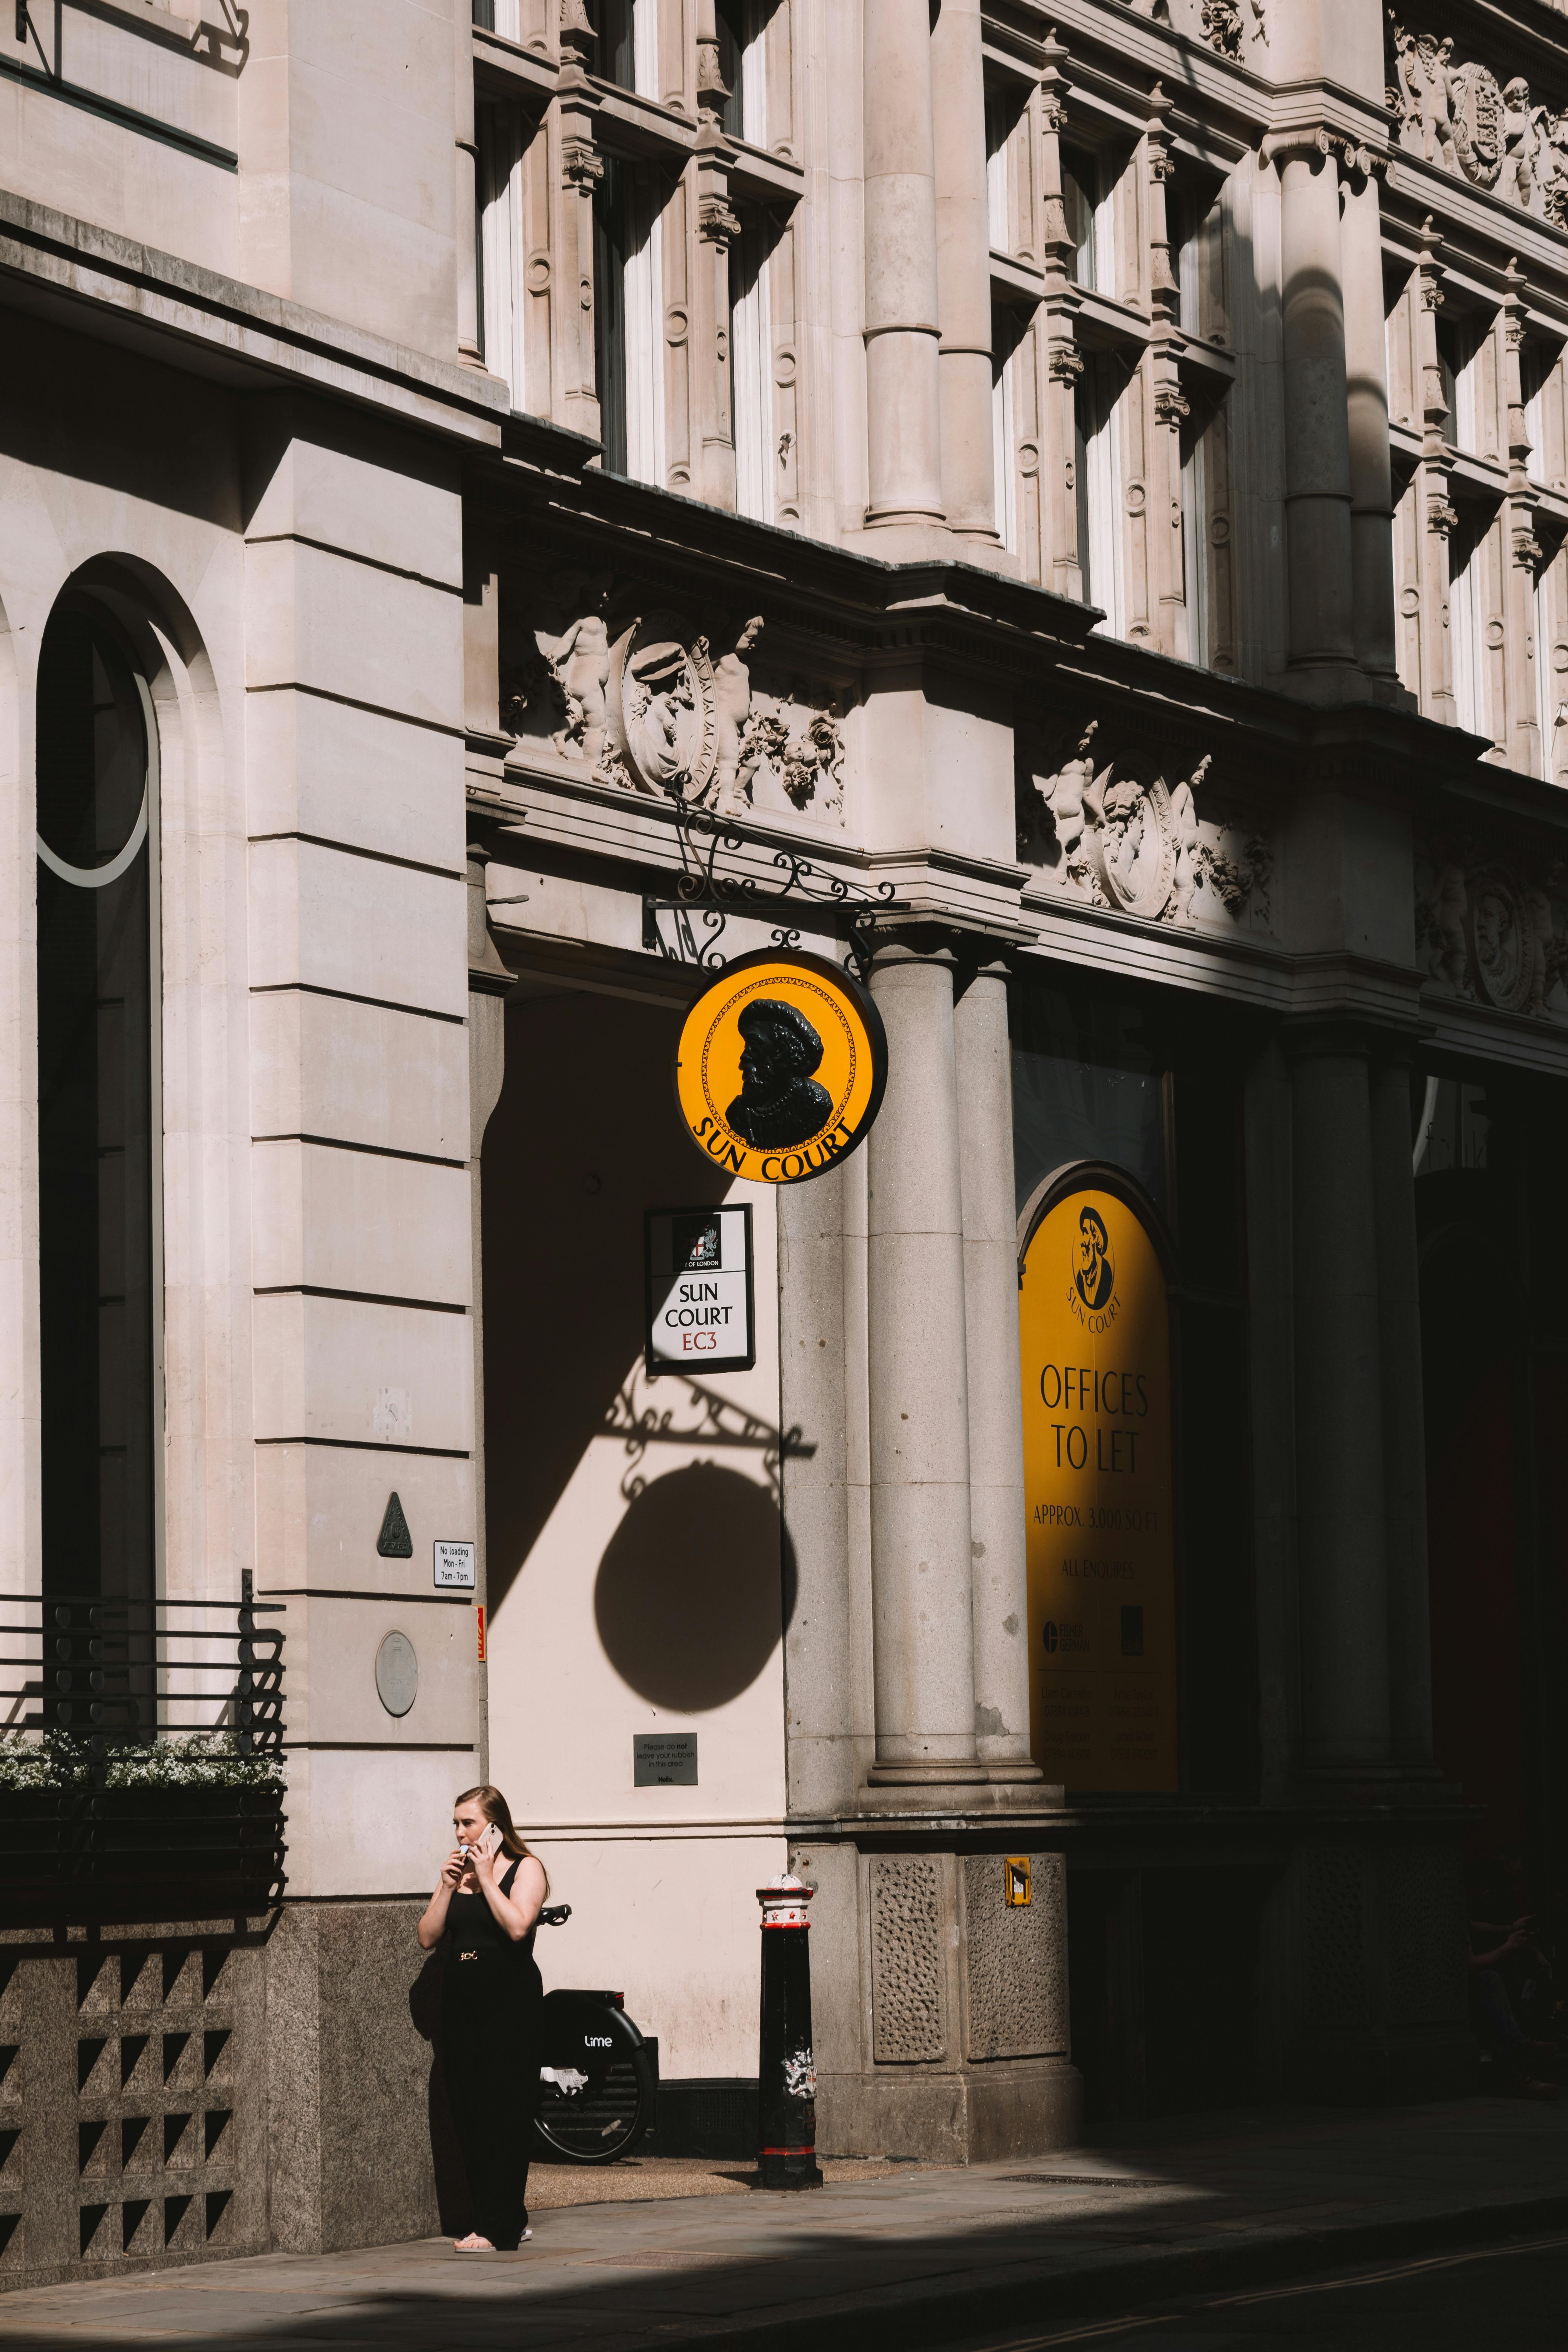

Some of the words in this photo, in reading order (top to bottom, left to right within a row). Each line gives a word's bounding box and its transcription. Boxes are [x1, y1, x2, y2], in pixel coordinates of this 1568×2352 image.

[692, 1117, 747, 1173] SUN
[761, 1117, 853, 1180] COURT
[680, 1283, 718, 1303] SUN
[665, 1306, 733, 1327] COURT
[1066, 1286, 1086, 1326] SUN
[1089, 1291, 1121, 1333] COURT
[683, 1332, 717, 1351] EC3
[1040, 1364, 1148, 1416] OFFICES
[1050, 1424, 1087, 1470] TO
[1098, 1429, 1139, 1473] LET
[1034, 1504, 1084, 1527] APPROX.
[1089, 1507, 1121, 1530] 3,000
[1126, 1510, 1143, 1533] SQ
[1146, 1511, 1159, 1532] FT
[440, 1546, 447, 1554] No
[450, 1547, 468, 1557] loading
[443, 1559, 454, 1567] Mon
[1062, 1558, 1080, 1576] ALL
[1084, 1559, 1134, 1580] ENQUIRES
[441, 1571, 452, 1580] 7am
[456, 1572, 468, 1582] 7pm
[1060, 1624, 1083, 1637] FISHER
[1060, 1638, 1090, 1652] GERMAN
[1041, 1687, 1058, 1698] Liam
[585, 2036, 612, 2047] Lime
